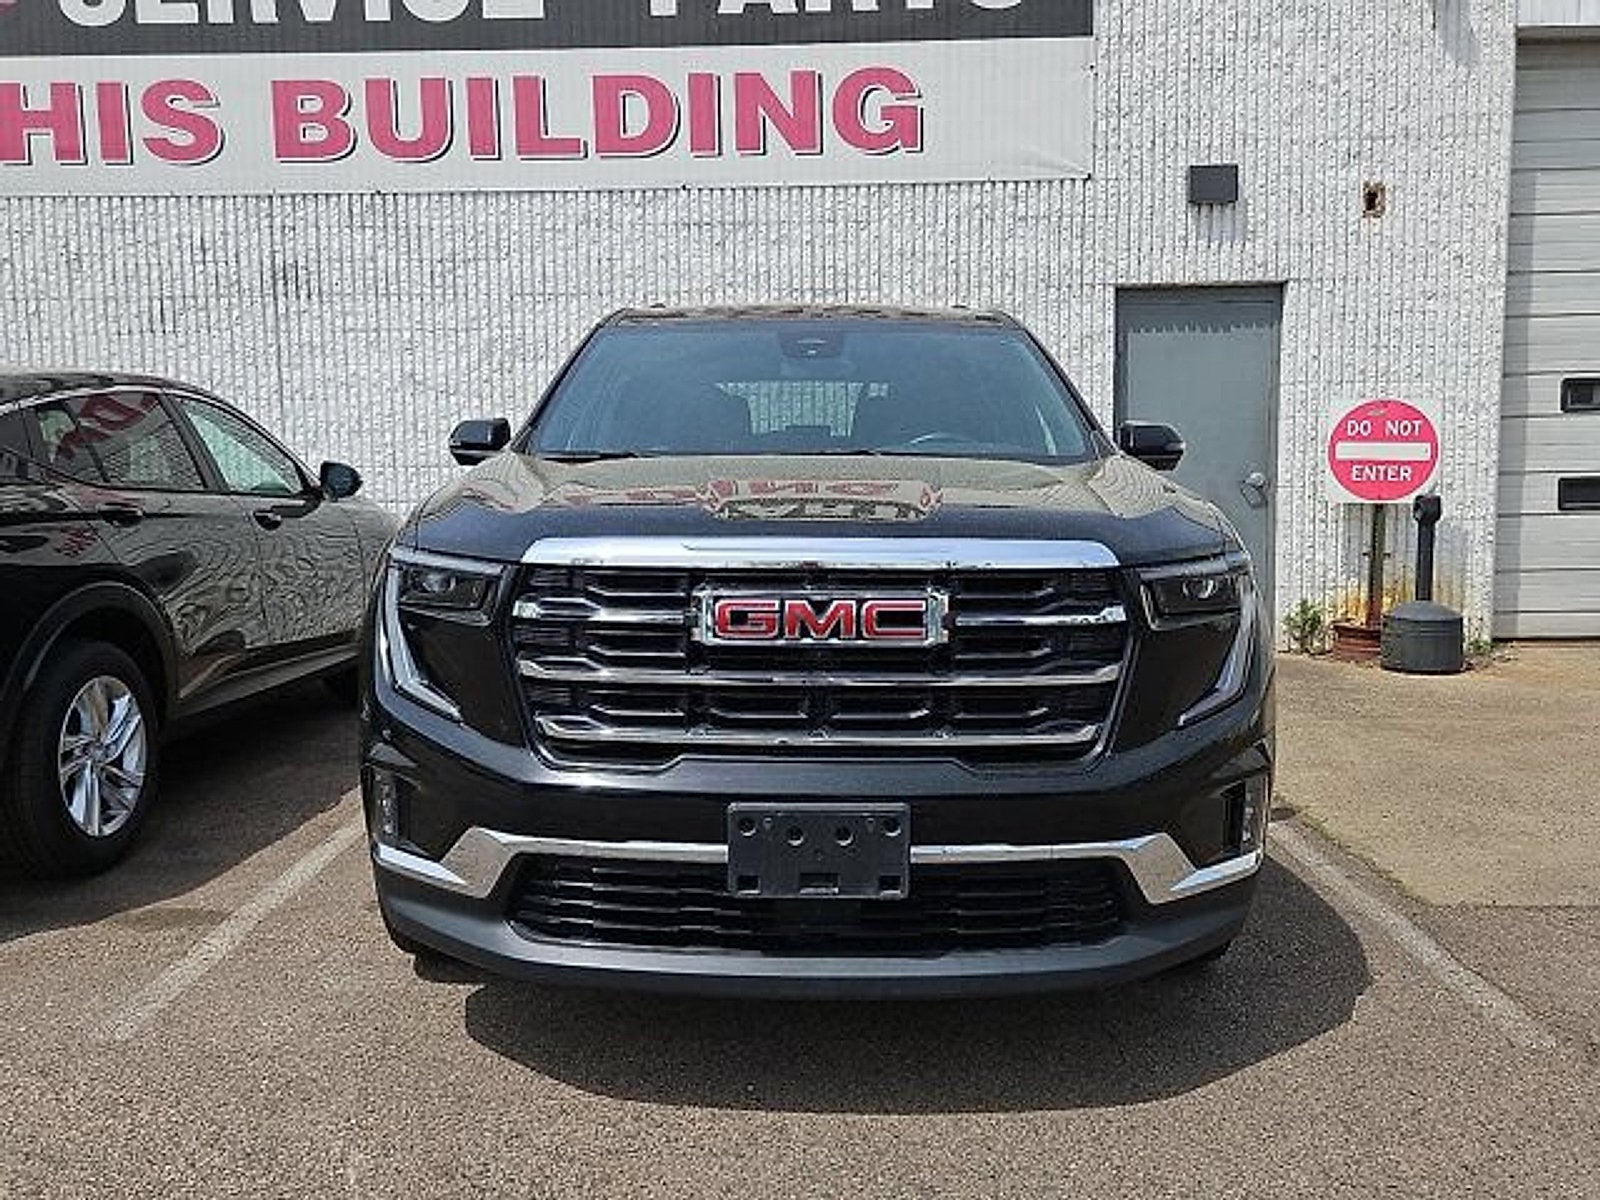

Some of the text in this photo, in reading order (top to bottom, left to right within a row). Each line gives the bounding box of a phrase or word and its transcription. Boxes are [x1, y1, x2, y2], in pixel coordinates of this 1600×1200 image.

[271, 66, 923, 164] BUILDING
[1347, 420, 1422, 436] DO NOT
[1352, 465, 1412, 481] ENTER
[714, 599, 926, 638] GMC
